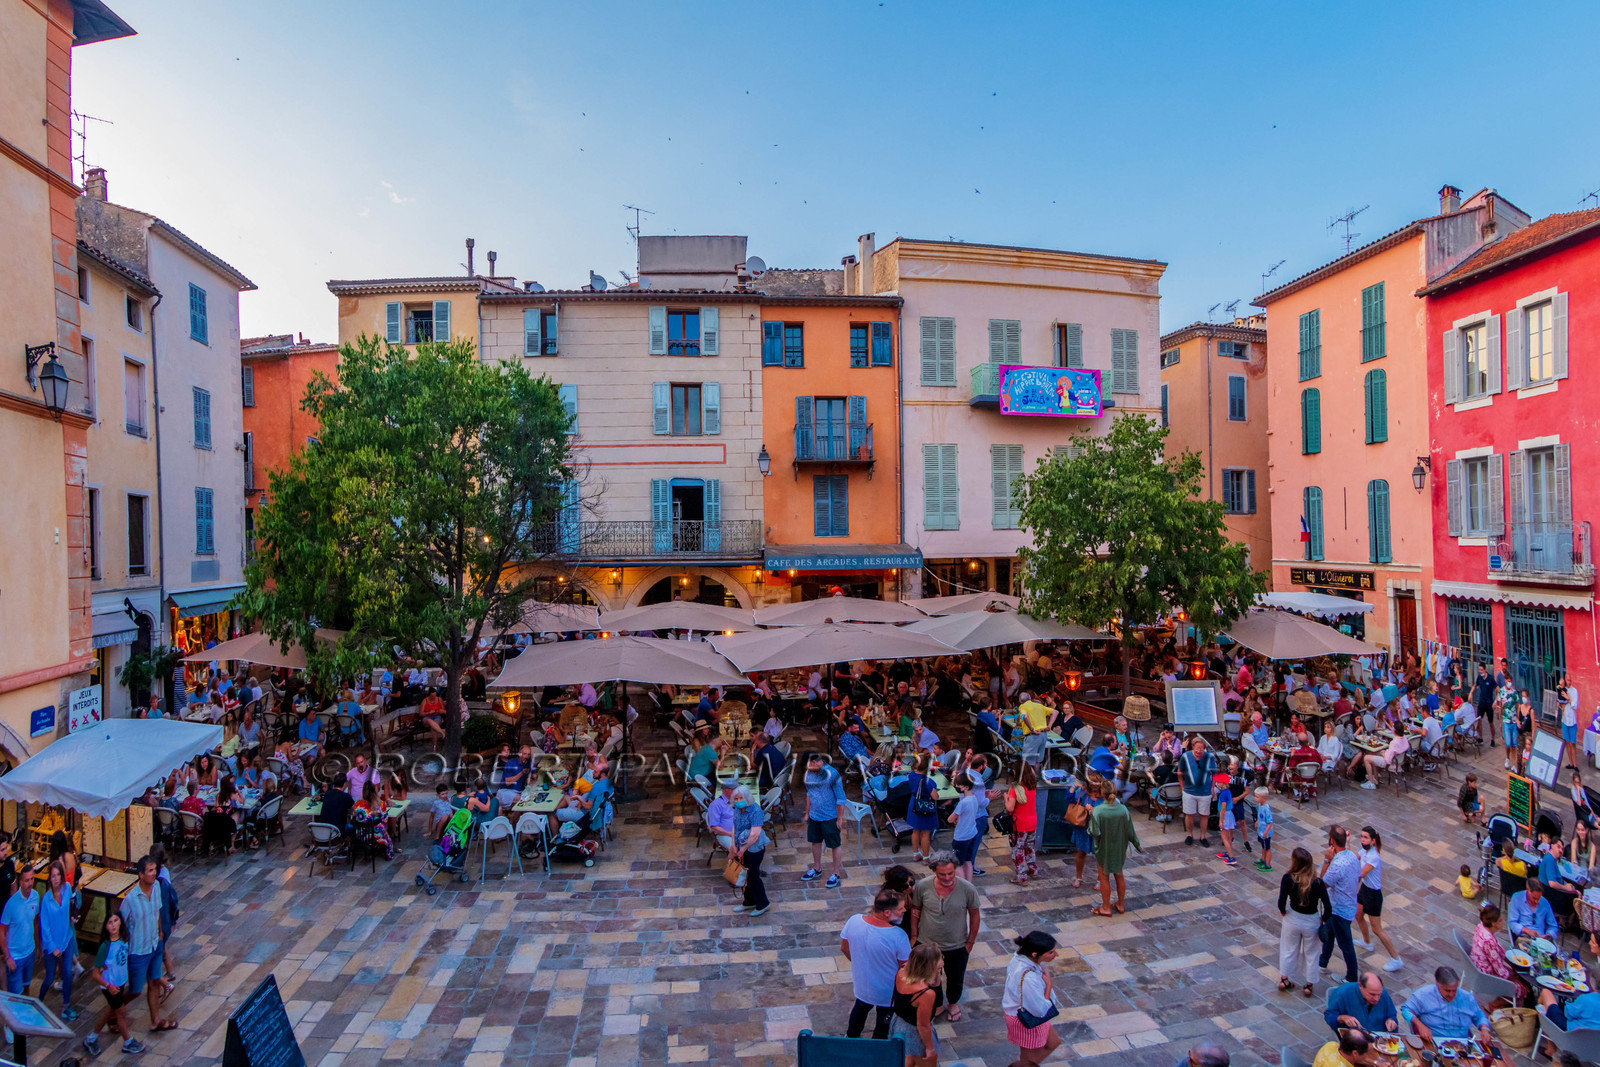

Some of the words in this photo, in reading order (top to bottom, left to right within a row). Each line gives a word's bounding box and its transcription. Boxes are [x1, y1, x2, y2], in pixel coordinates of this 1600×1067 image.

[1015, 371, 1053, 385] FESTIVAL
[767, 559, 791, 567] CAFE
[794, 558, 813, 567] DES
[816, 558, 857, 566] ARCADES
[863, 557, 921, 566] RESTAURANT
[79, 689, 92, 699] JEUX
[72, 697, 99, 711] INTERDITS
